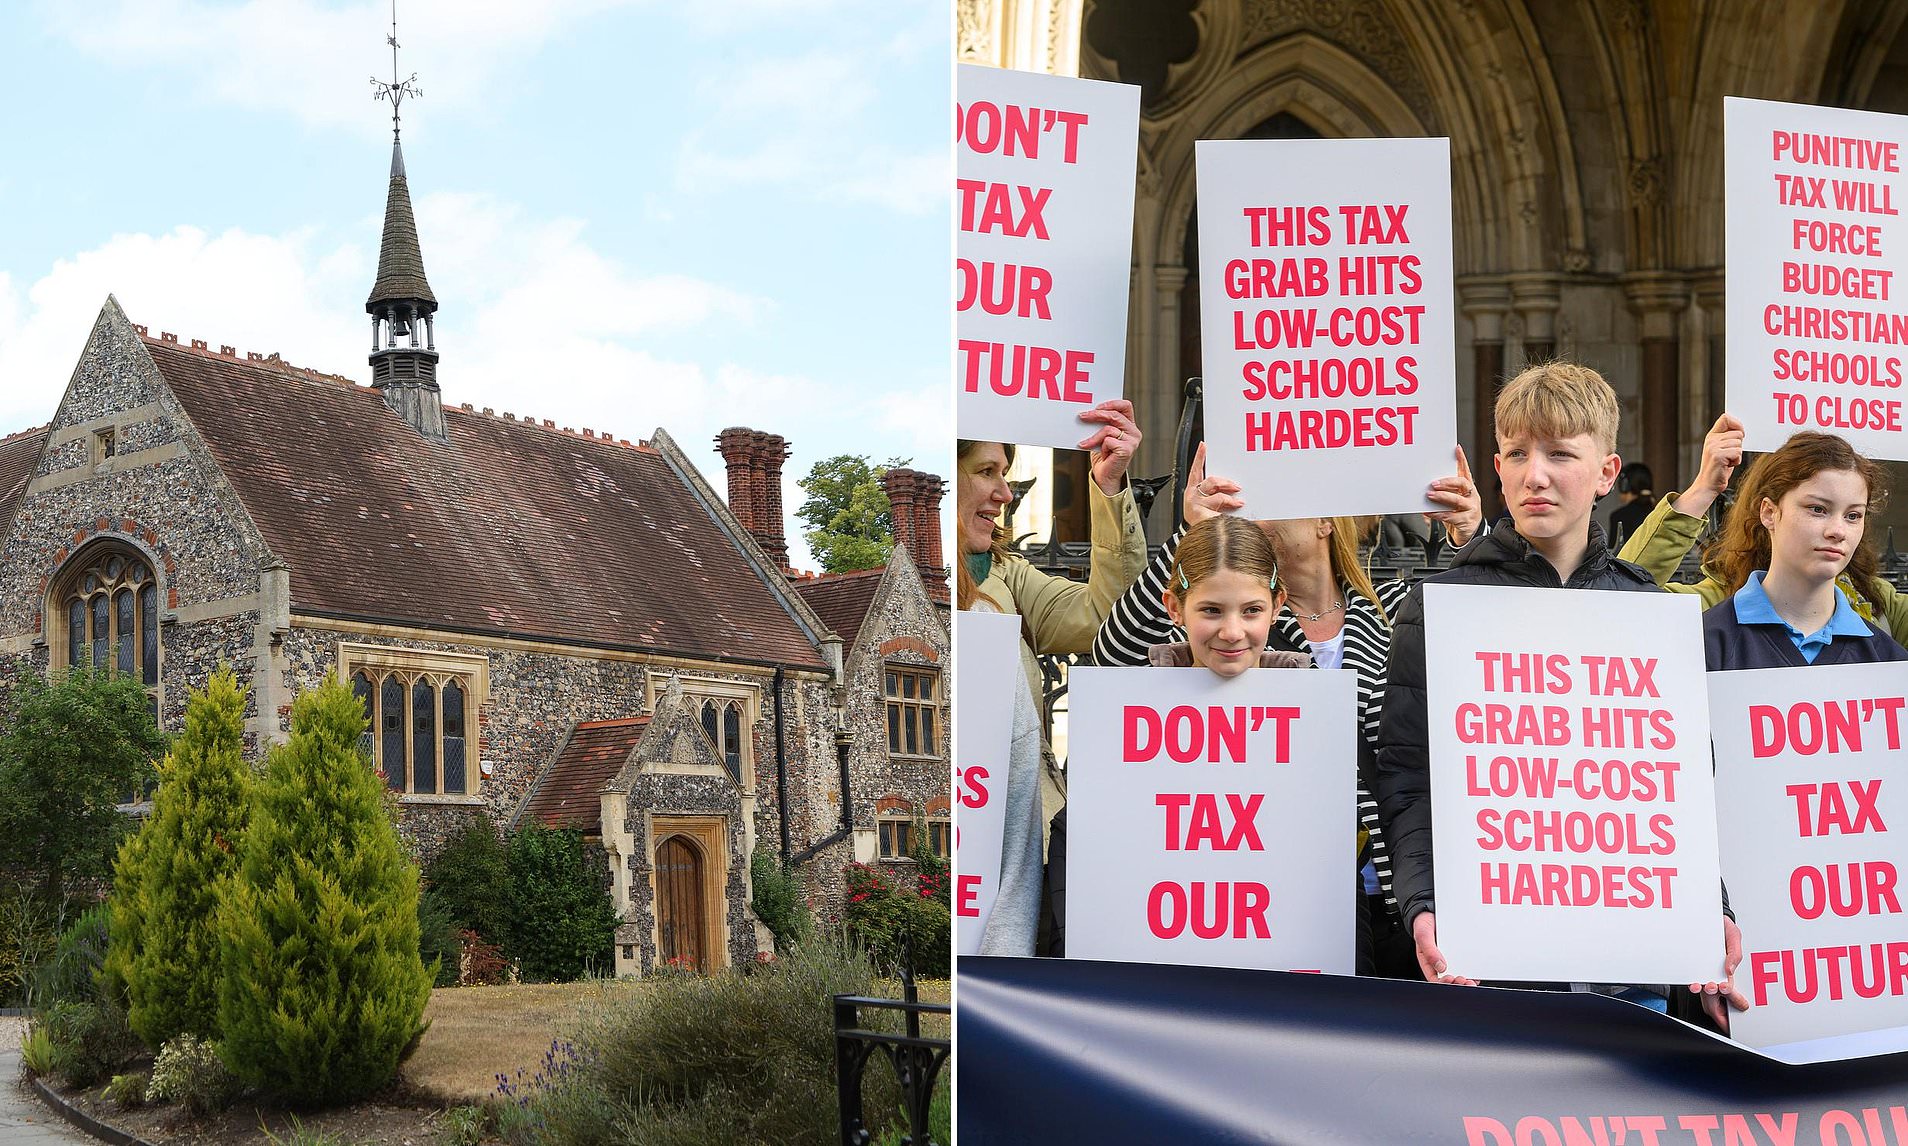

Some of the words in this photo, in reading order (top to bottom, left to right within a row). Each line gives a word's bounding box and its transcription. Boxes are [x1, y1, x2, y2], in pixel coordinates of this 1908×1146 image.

[957, 101, 1088, 164] ON'T
[1773, 131, 1900, 173] PUNITIVE
[957, 178, 1053, 240] TAX
[1775, 174, 1827, 209] TAX
[1832, 179, 1899, 215] WILL
[1243, 206, 1331, 247] THIS
[1339, 205, 1410, 245] TAX
[1793, 219, 1883, 257] FORCE
[1224, 257, 1329, 299] GRAB
[1339, 255, 1423, 296] HITS
[1783, 262, 1893, 301] BUDGET
[1234, 306, 1426, 351] LOW-COST
[1764, 304, 1908, 346] CHRISTIAN
[958, 339, 1095, 404] TURE
[1243, 356, 1419, 402] SCHOOLS
[1773, 349, 1902, 389] SCHOOLS
[1246, 406, 1420, 452] HARDEST
[1773, 392, 1808, 425] TO
[1815, 396, 1902, 432] CLOSE
[1476, 652, 1572, 695] THIS
[1581, 655, 1661, 697] TAX
[1123, 705, 1301, 763] DON'T
[1455, 703, 1571, 747] GRAB
[1582, 707, 1676, 750] HITS
[1749, 697, 1906, 758] DON'T
[1466, 756, 1680, 802] LOW-COST
[1156, 794, 1265, 851] TAX
[1786, 779, 1887, 837] TAX
[1477, 808, 1676, 856] SCHOOLS
[1481, 863, 1678, 909] HARDEST
[1790, 861, 1903, 920] OUR
[1147, 881, 1271, 940] OUR
